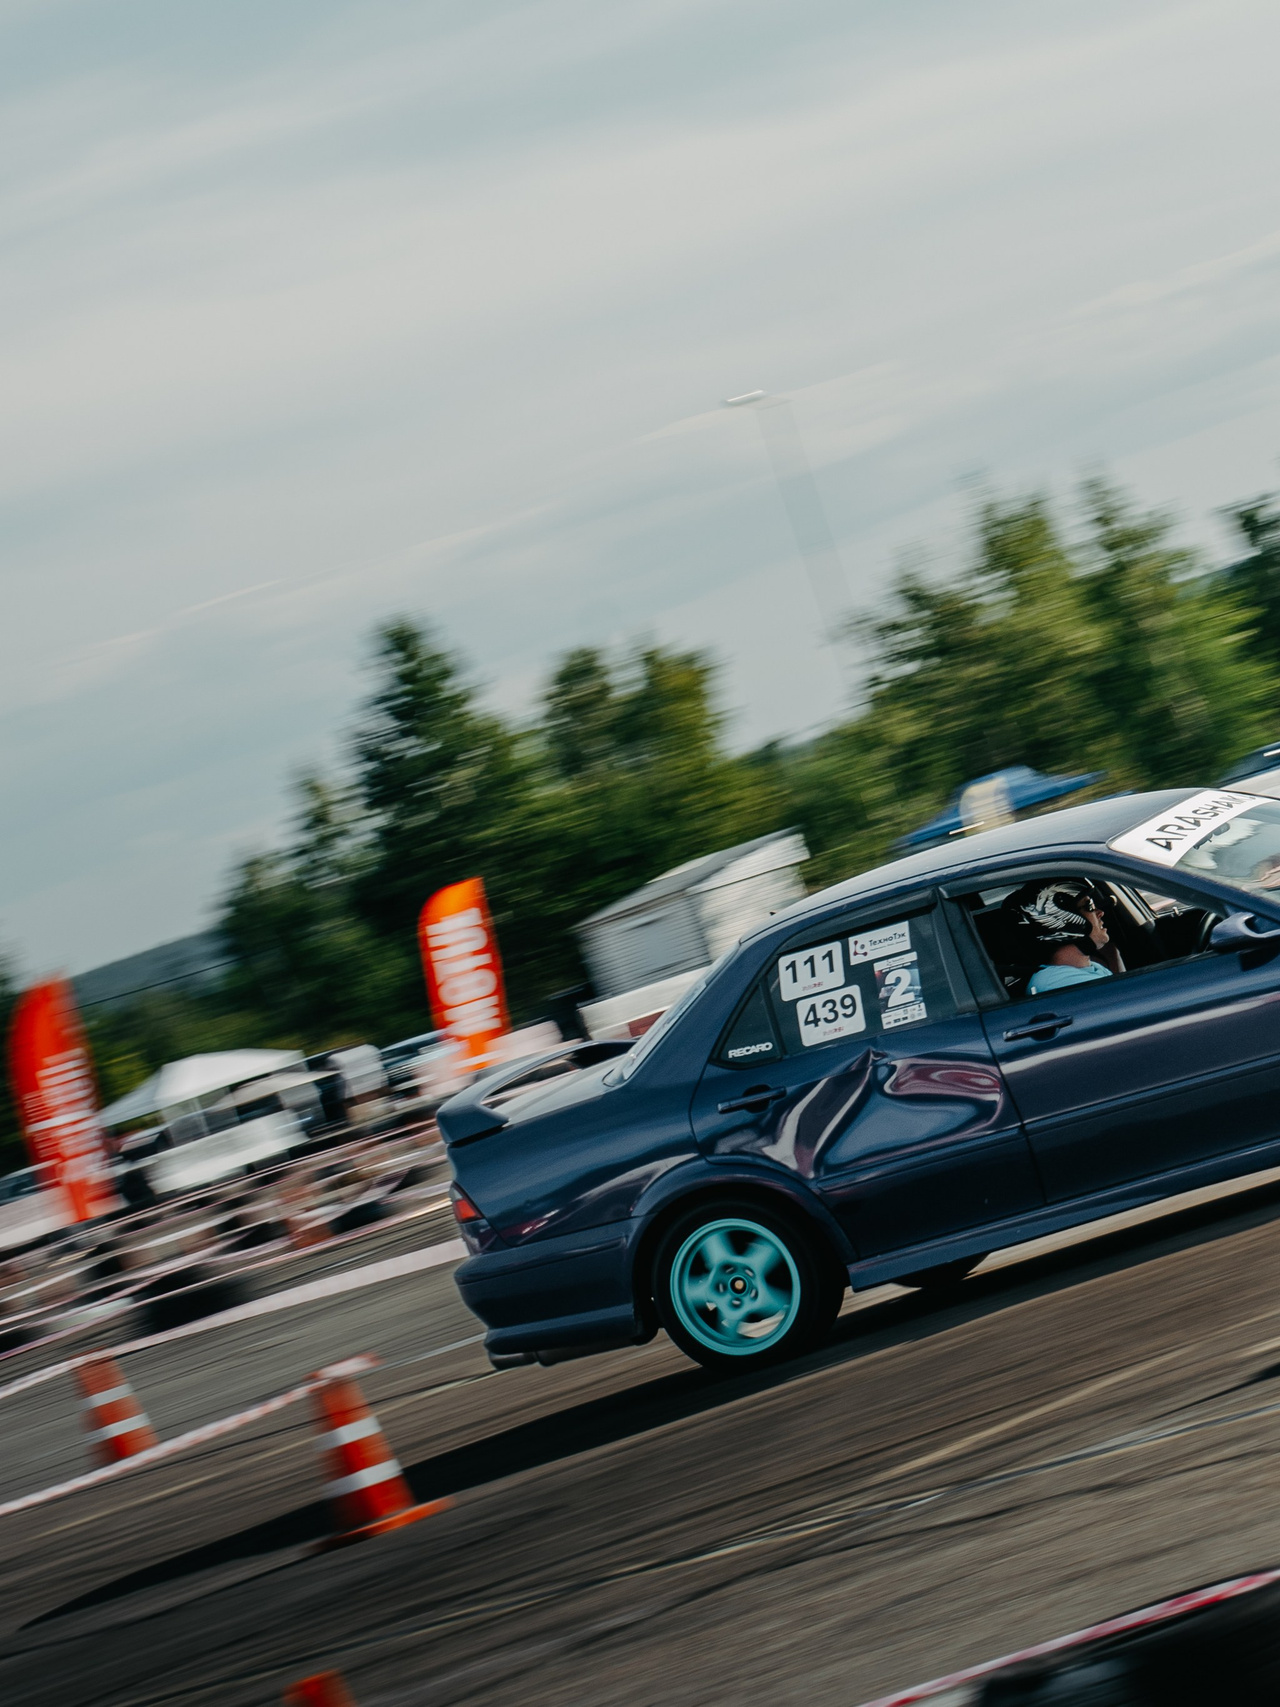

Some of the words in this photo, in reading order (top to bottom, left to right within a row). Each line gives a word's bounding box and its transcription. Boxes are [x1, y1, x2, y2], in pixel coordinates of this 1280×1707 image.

[425, 907, 502, 1038] MOTUL
[785, 949, 835, 984] 111
[884, 968, 916, 1008] 2
[803, 993, 857, 1028] 439
[728, 1041, 774, 1059] RECARO
